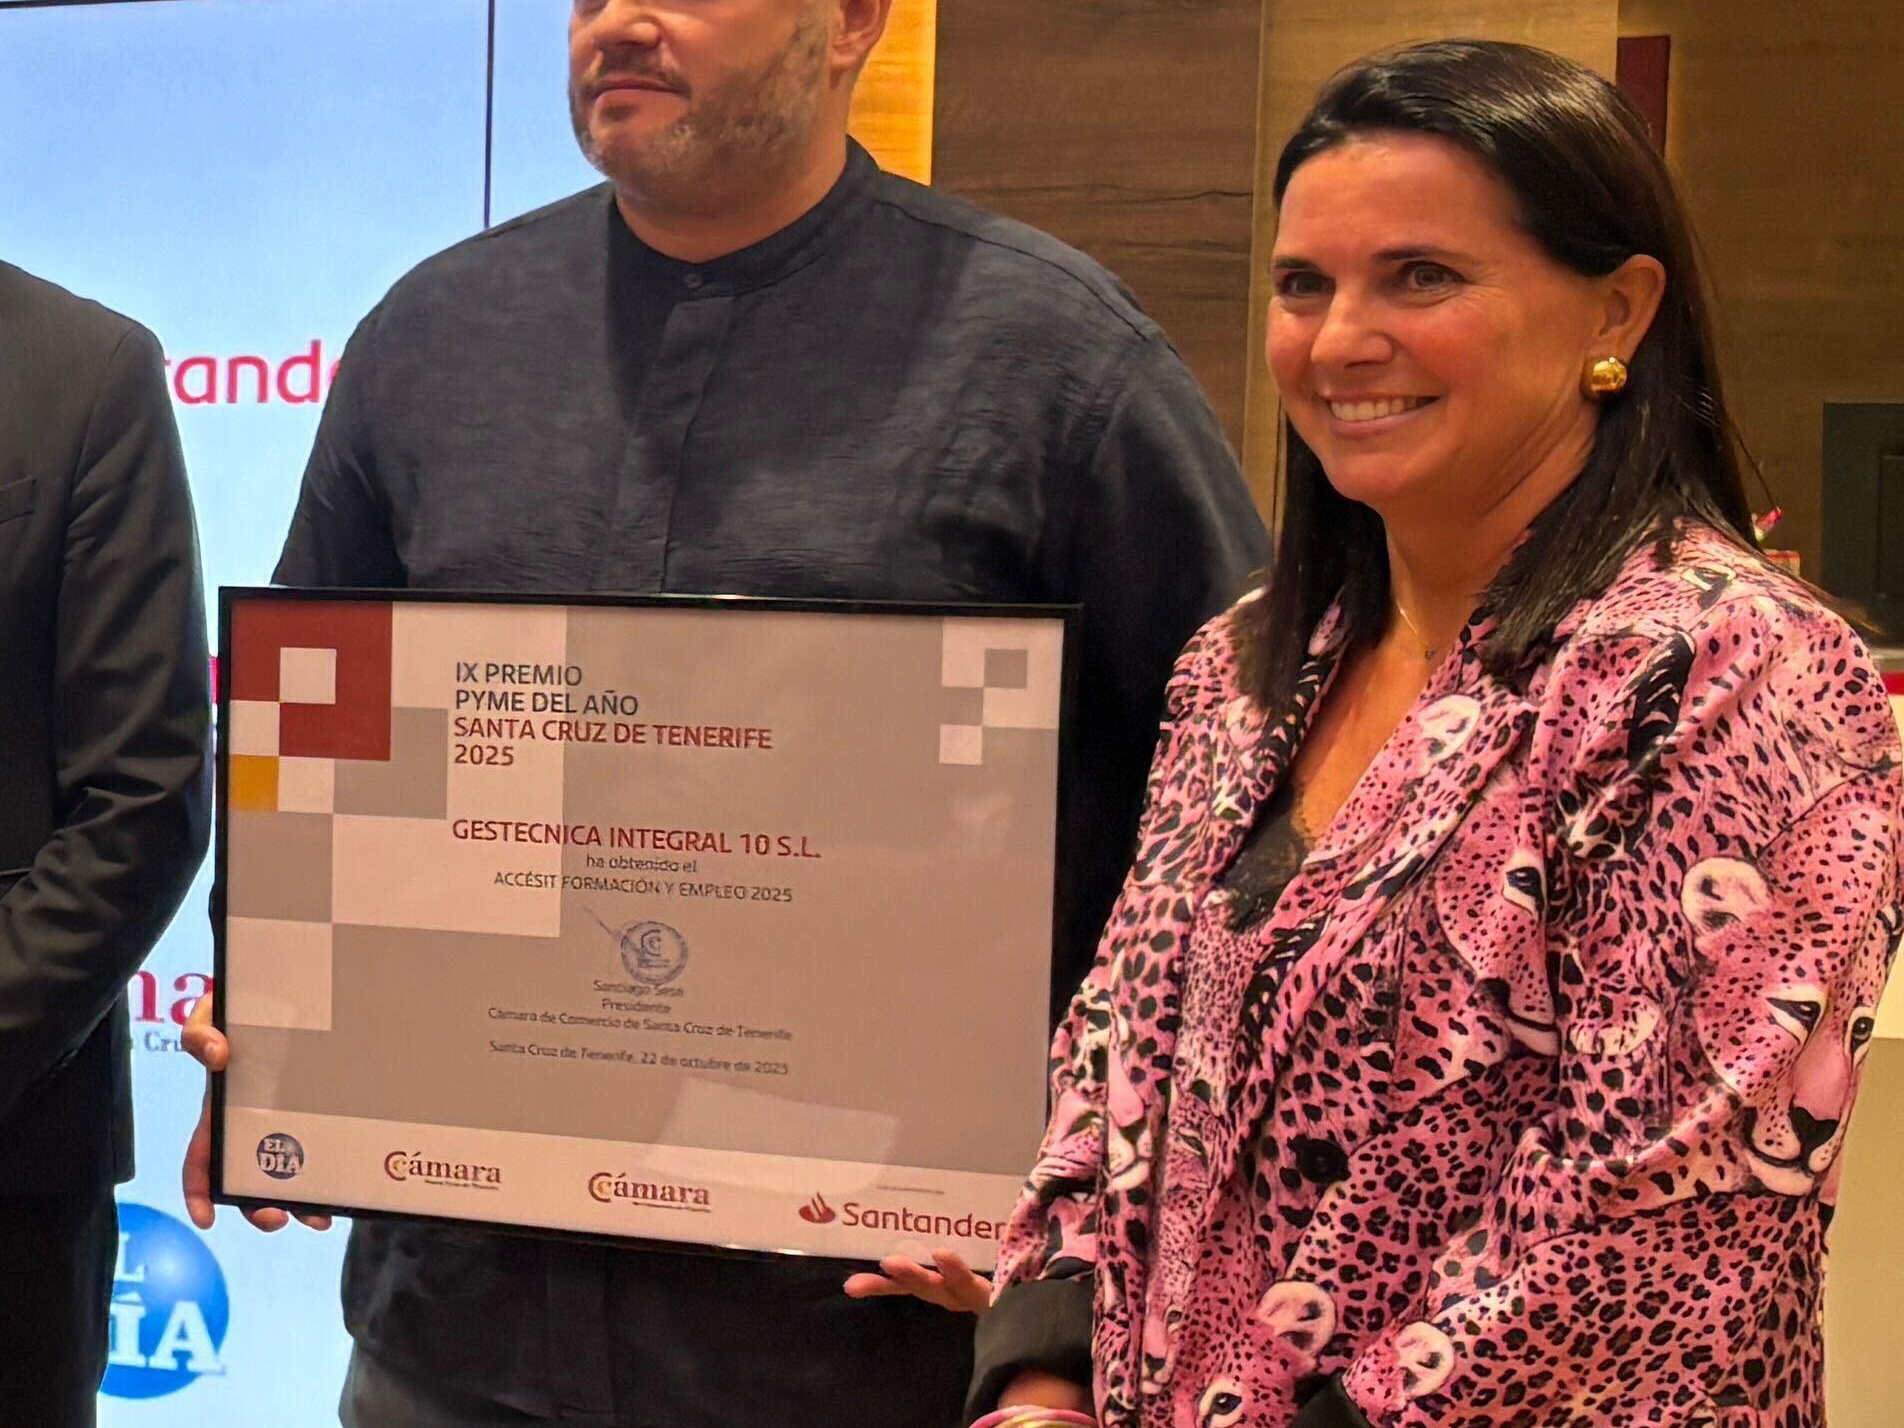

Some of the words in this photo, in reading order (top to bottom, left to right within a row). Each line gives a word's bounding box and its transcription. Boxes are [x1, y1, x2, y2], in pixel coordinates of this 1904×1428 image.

[456, 662, 479, 684] IX
[485, 662, 583, 687] PREMIO
[455, 690, 525, 713] PYME
[532, 693, 578, 714] DEL
[582, 690, 639, 716] AÑO
[454, 717, 536, 741] SANTA
[542, 719, 607, 744] CRUZ
[613, 723, 648, 746] DE
[652, 724, 774, 750] TENERIFE
[454, 744, 515, 767] 2025
[452, 819, 603, 847] GESTECNICA
[609, 827, 732, 854] INTEGRAL
[740, 832, 770, 856] 10
[750, 886, 793, 903] 2025
[384, 1150, 501, 1183] Cámara
[589, 1172, 710, 1205] Cámara
[842, 1202, 1007, 1240] Santander
